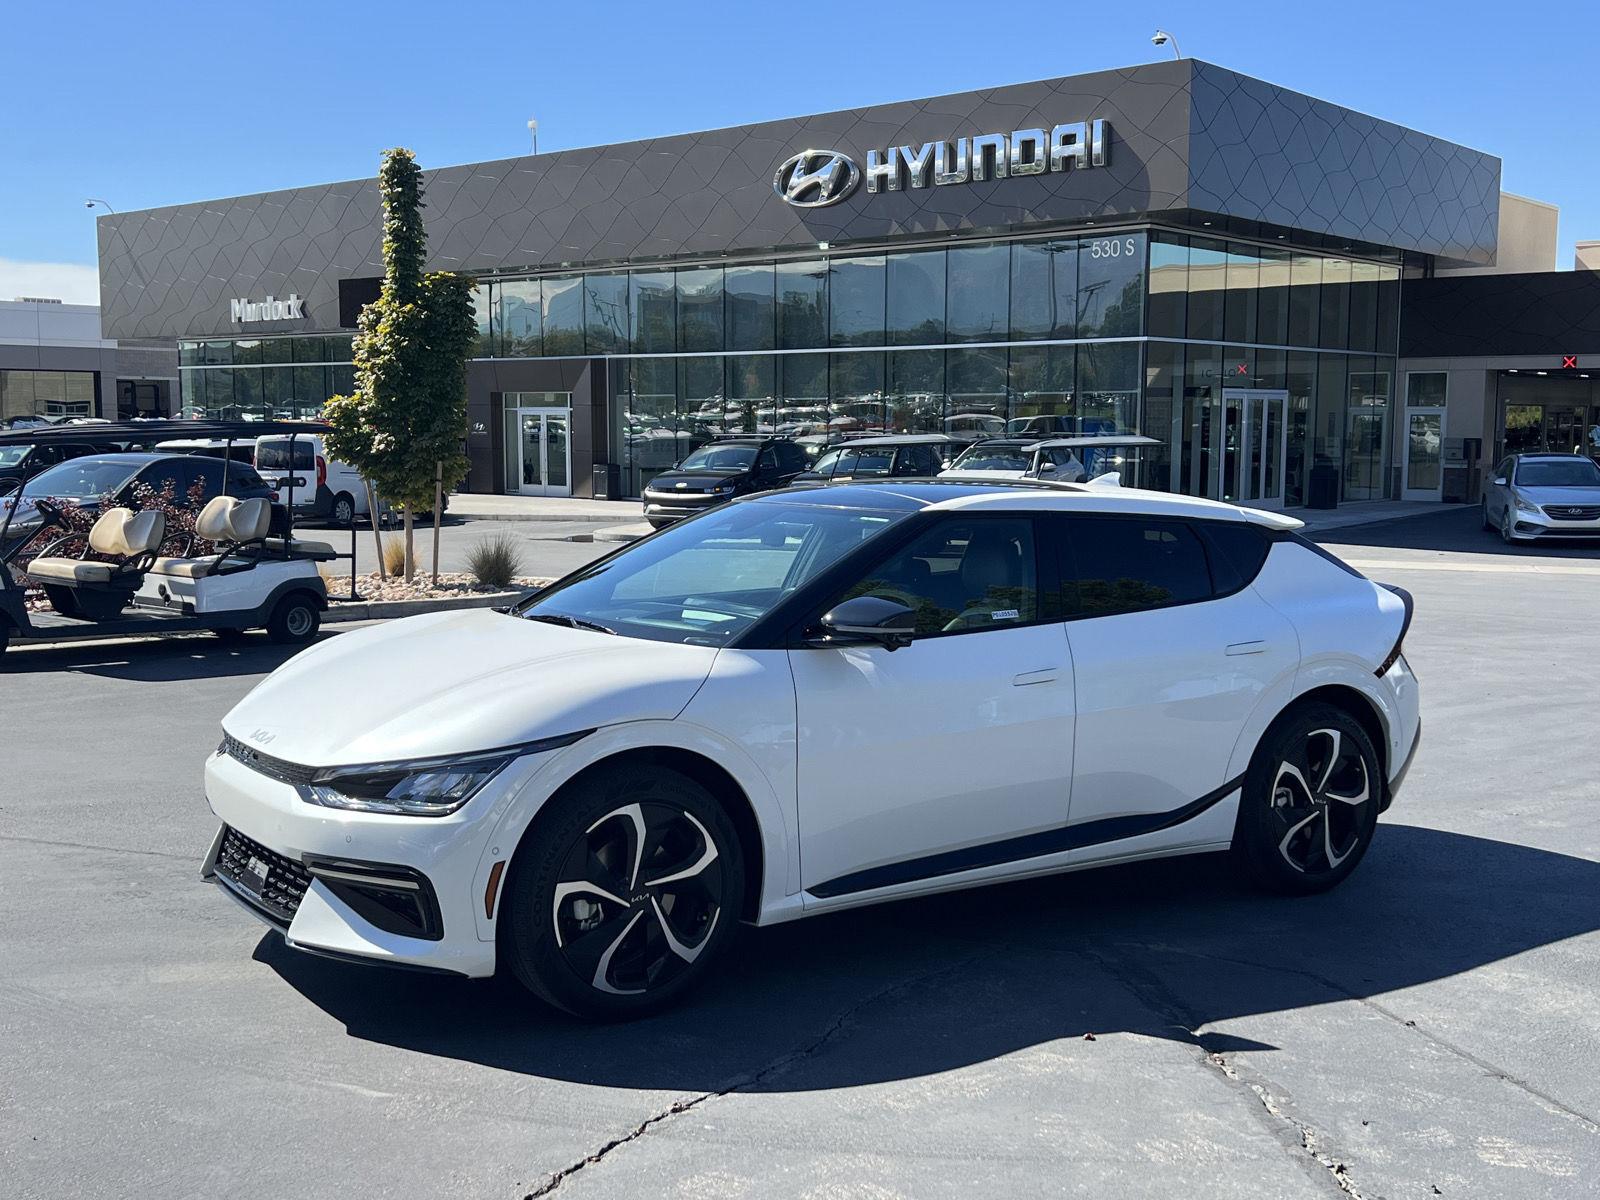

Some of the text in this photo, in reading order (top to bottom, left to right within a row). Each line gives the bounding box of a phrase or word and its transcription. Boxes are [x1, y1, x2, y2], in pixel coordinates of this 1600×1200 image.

[866, 119, 1109, 193] HYUNDAI
[1091, 238, 1135, 258] 530 S
[230, 293, 304, 323] Murdock
